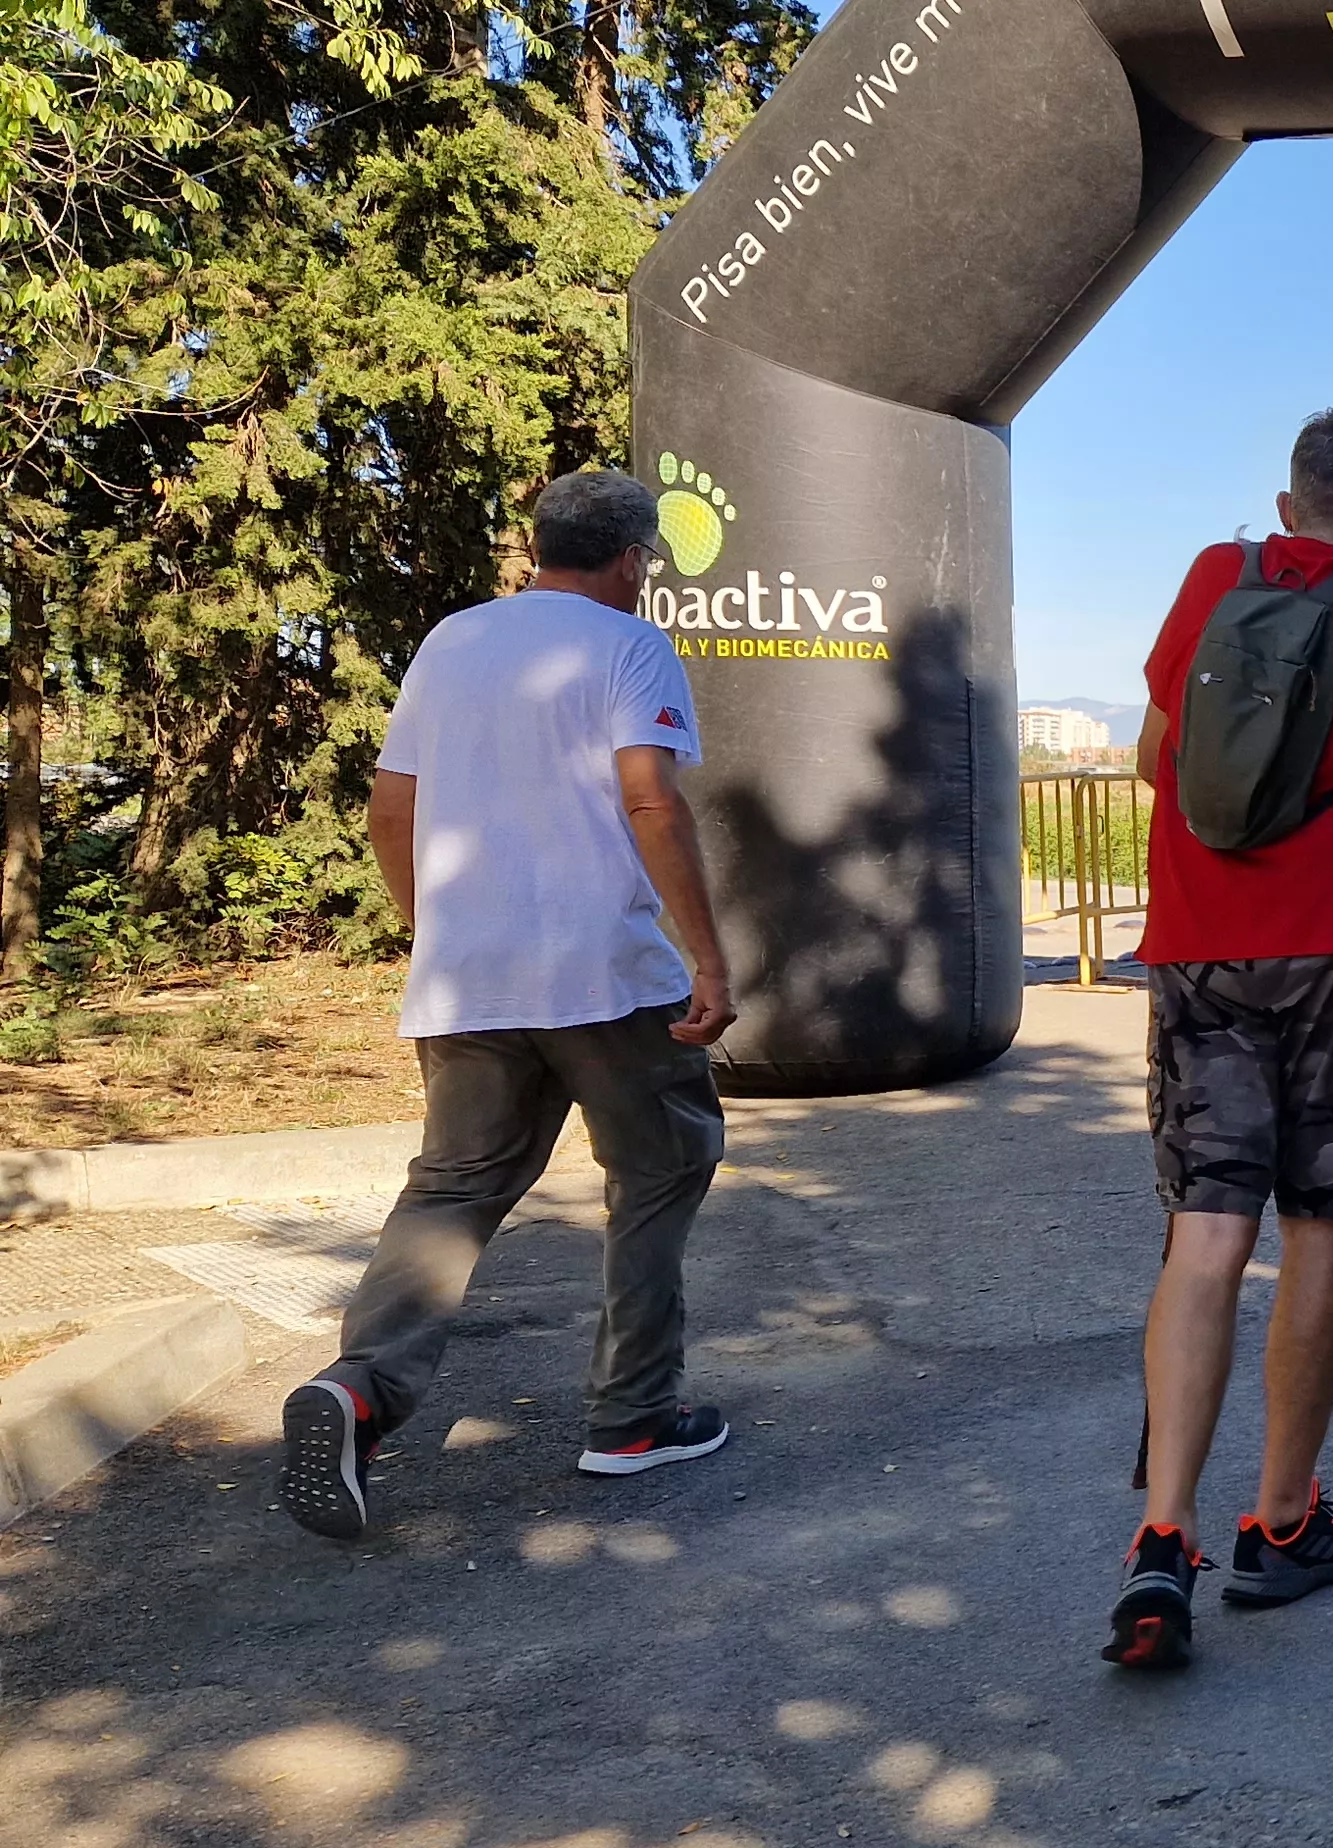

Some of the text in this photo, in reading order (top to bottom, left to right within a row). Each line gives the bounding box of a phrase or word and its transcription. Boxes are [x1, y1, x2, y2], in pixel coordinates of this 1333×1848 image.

[680, 230, 767, 323] Pisa
[755, 138, 857, 234] bien,
[843, 42, 918, 126] vive
[697, 638, 710, 657] Y
[716, 635, 890, 660] BIOMECÁNICA
